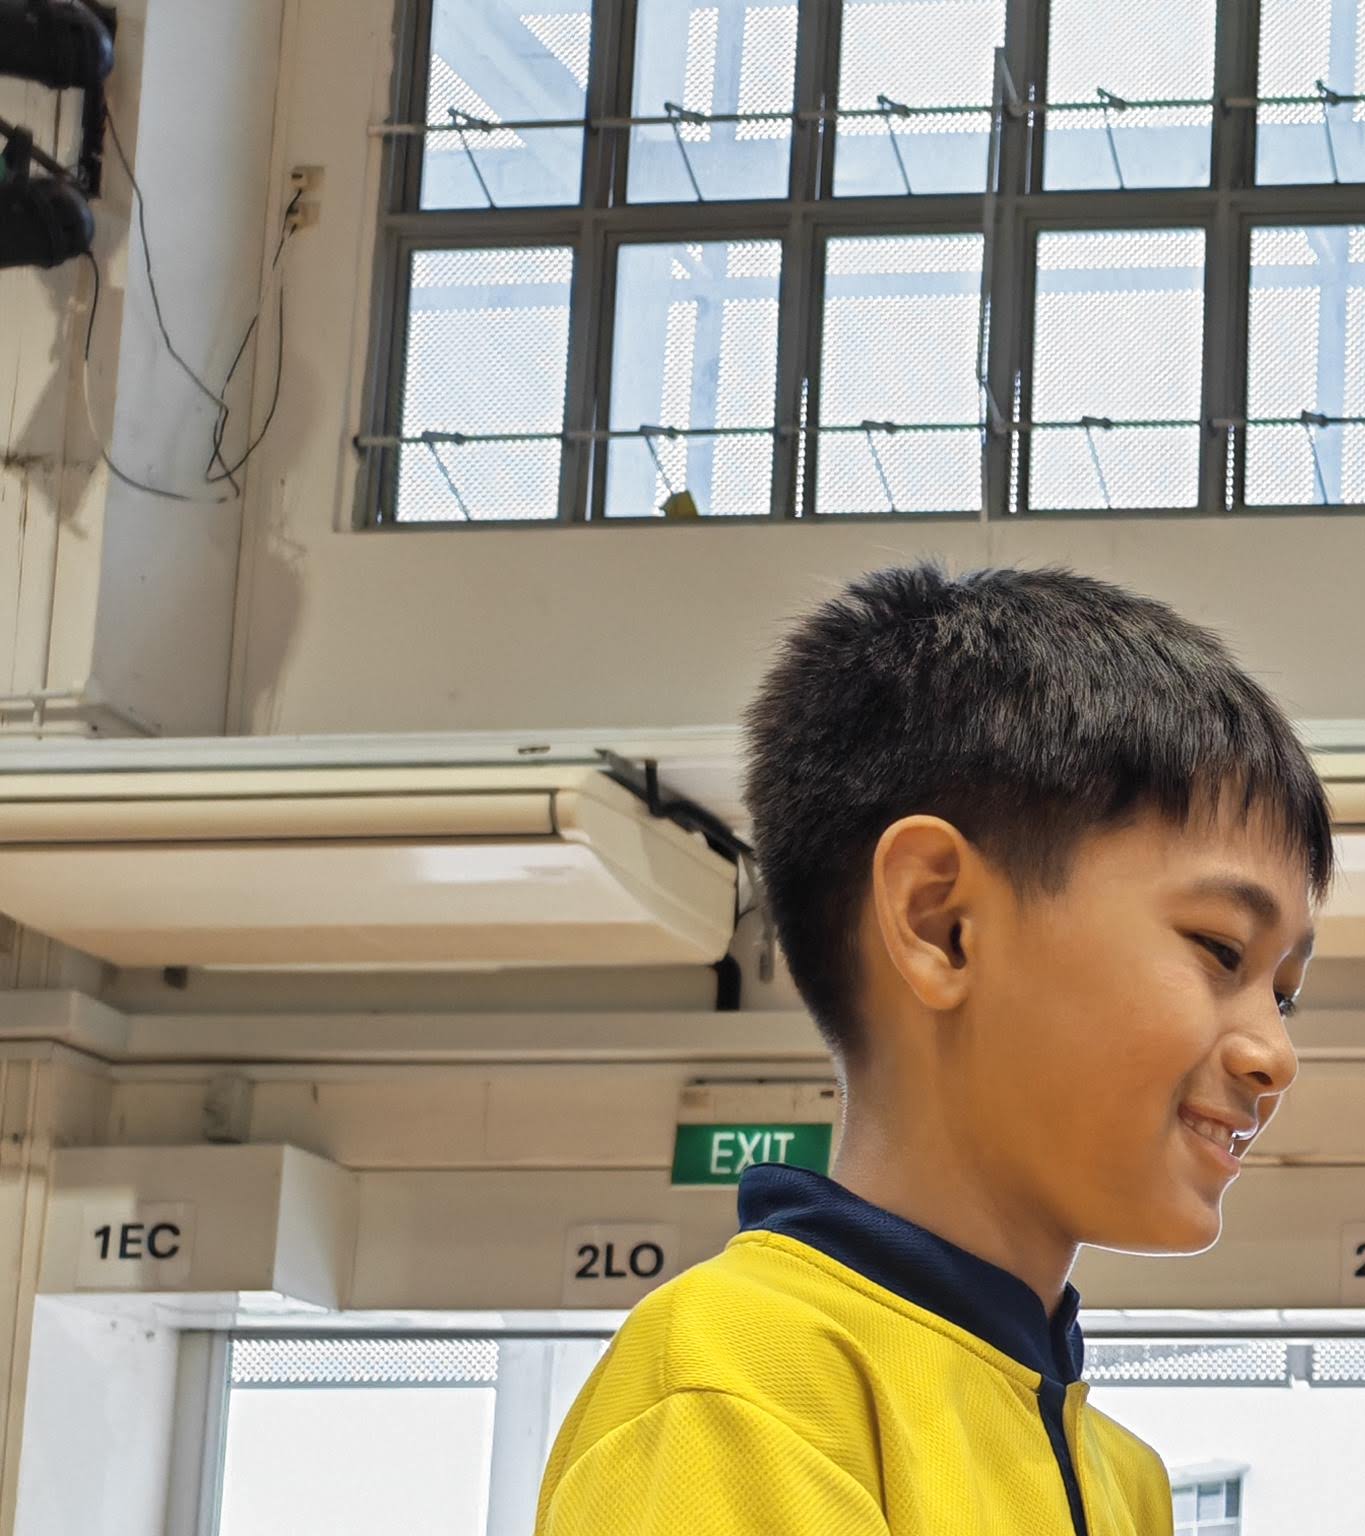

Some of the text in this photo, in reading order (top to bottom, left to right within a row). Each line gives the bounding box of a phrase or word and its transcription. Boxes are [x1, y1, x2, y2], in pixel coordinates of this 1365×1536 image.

[710, 1131, 795, 1174] EXIT
[94, 1222, 181, 1260] 1EC
[575, 1243, 664, 1279] 2LO
